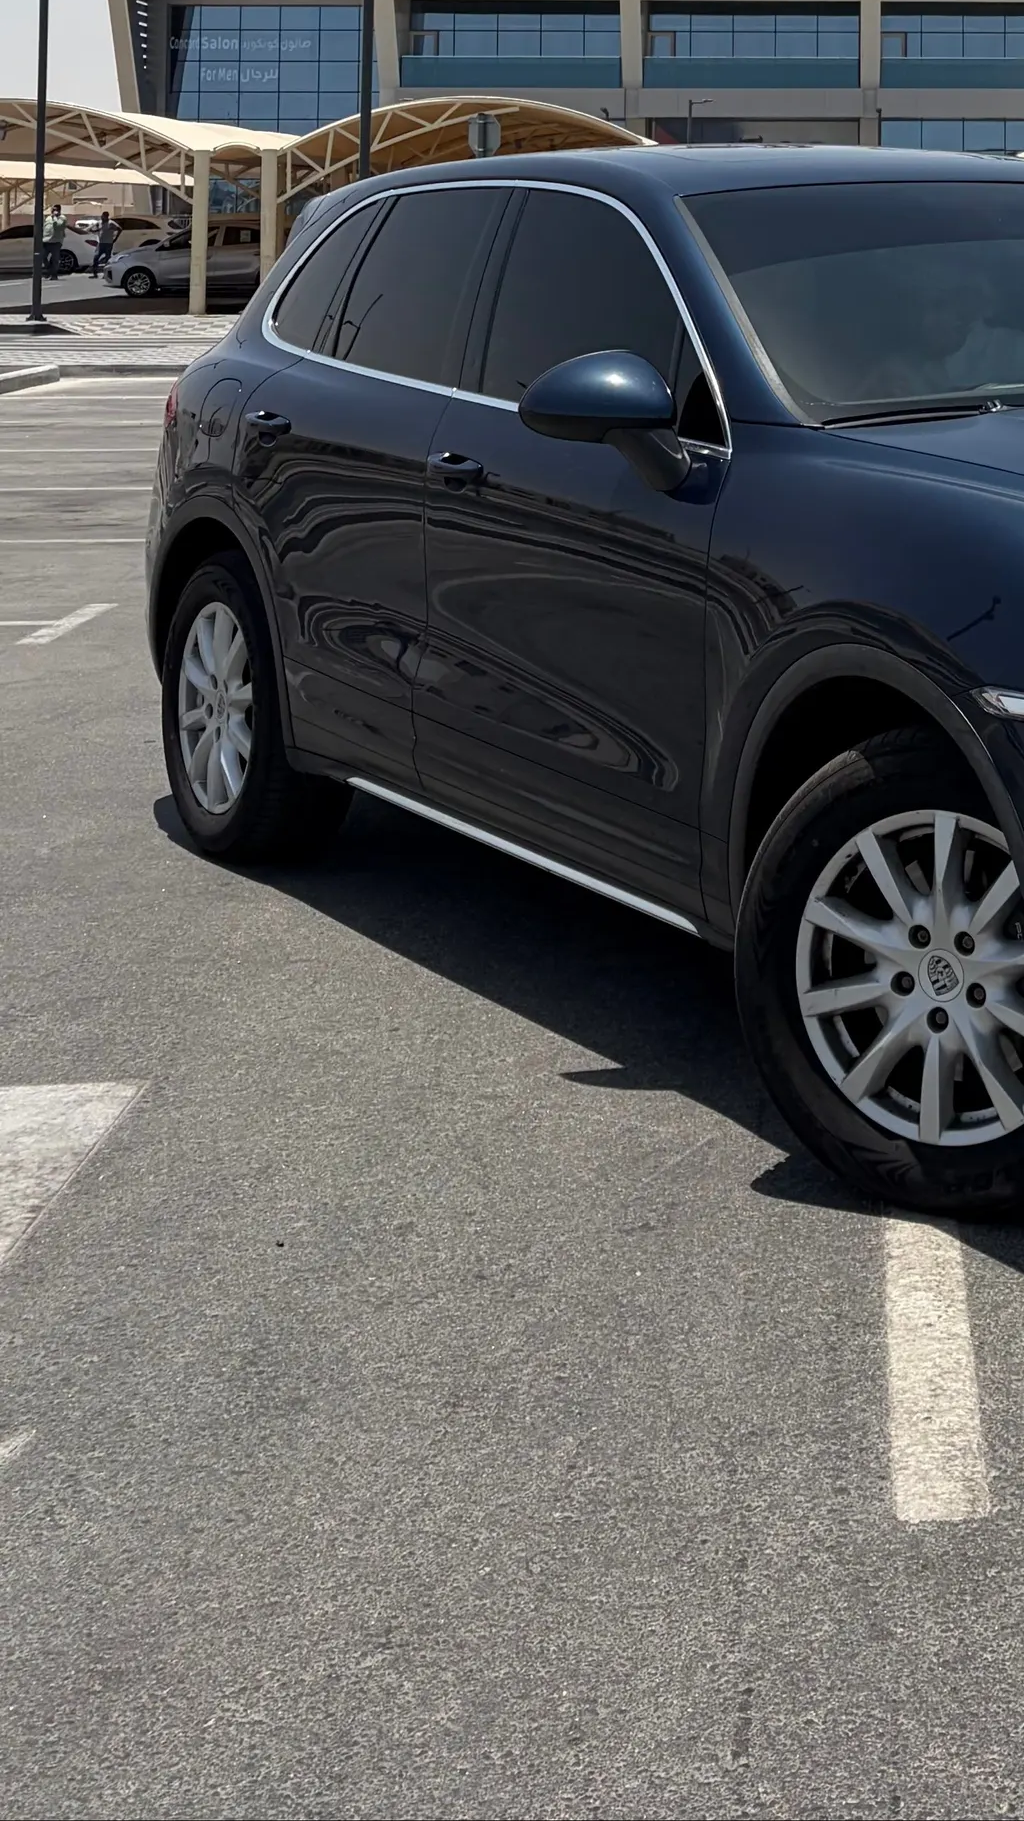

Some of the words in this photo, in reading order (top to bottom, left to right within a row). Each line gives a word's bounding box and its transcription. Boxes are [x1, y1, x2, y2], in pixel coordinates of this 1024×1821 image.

[201, 36, 239, 50] Salon
[201, 67, 216, 81] For
[218, 67, 239, 82] Men
